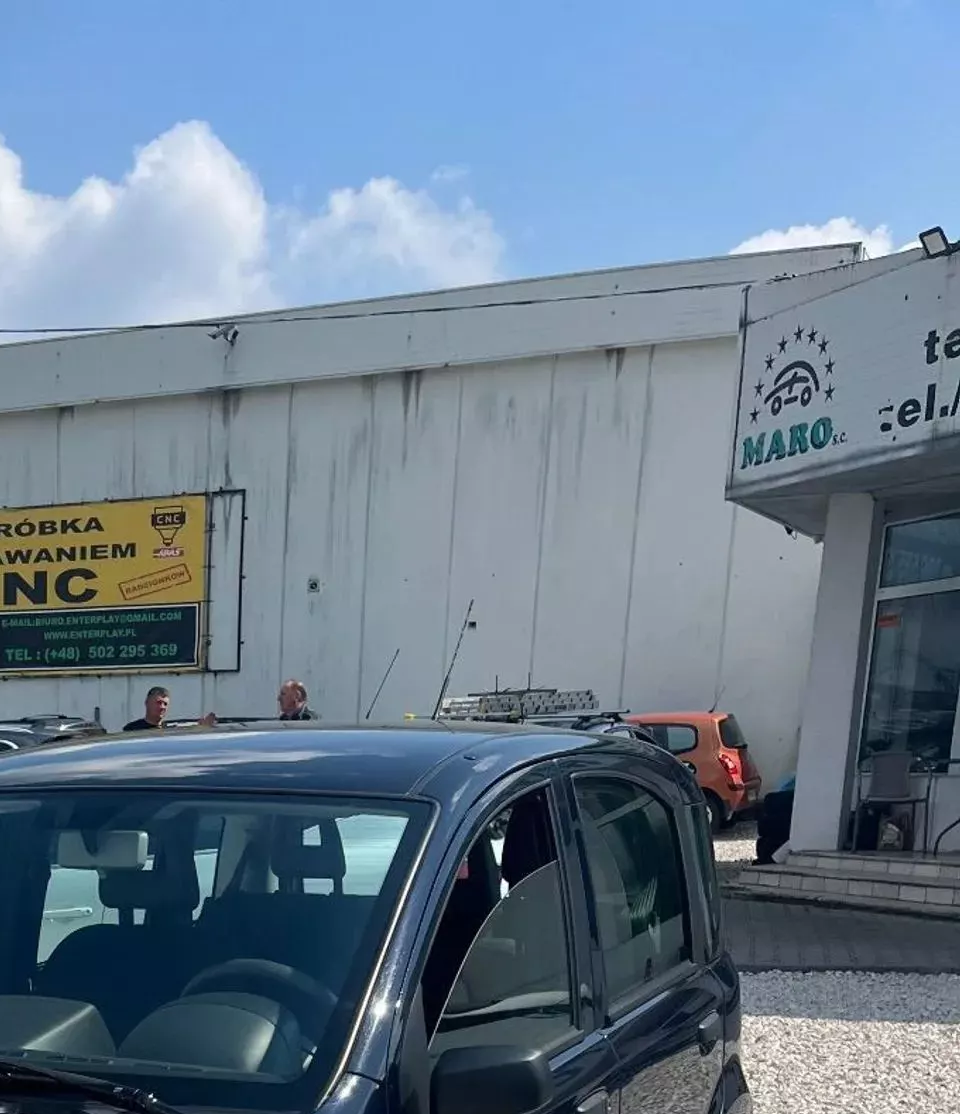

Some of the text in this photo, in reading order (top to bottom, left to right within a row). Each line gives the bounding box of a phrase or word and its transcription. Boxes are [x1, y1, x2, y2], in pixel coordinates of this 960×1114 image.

[740, 416, 834, 470] MARO
[157, 514, 181, 524] CNC
[44, 628, 137, 640] WWW.ENTERPLAY.PL
[5, 648, 32, 661] TEL
[44, 647, 80, 664] (+48)
[88, 645, 115, 659] 502
[119, 644, 145, 658] 295
[150, 643, 178, 657] 369
